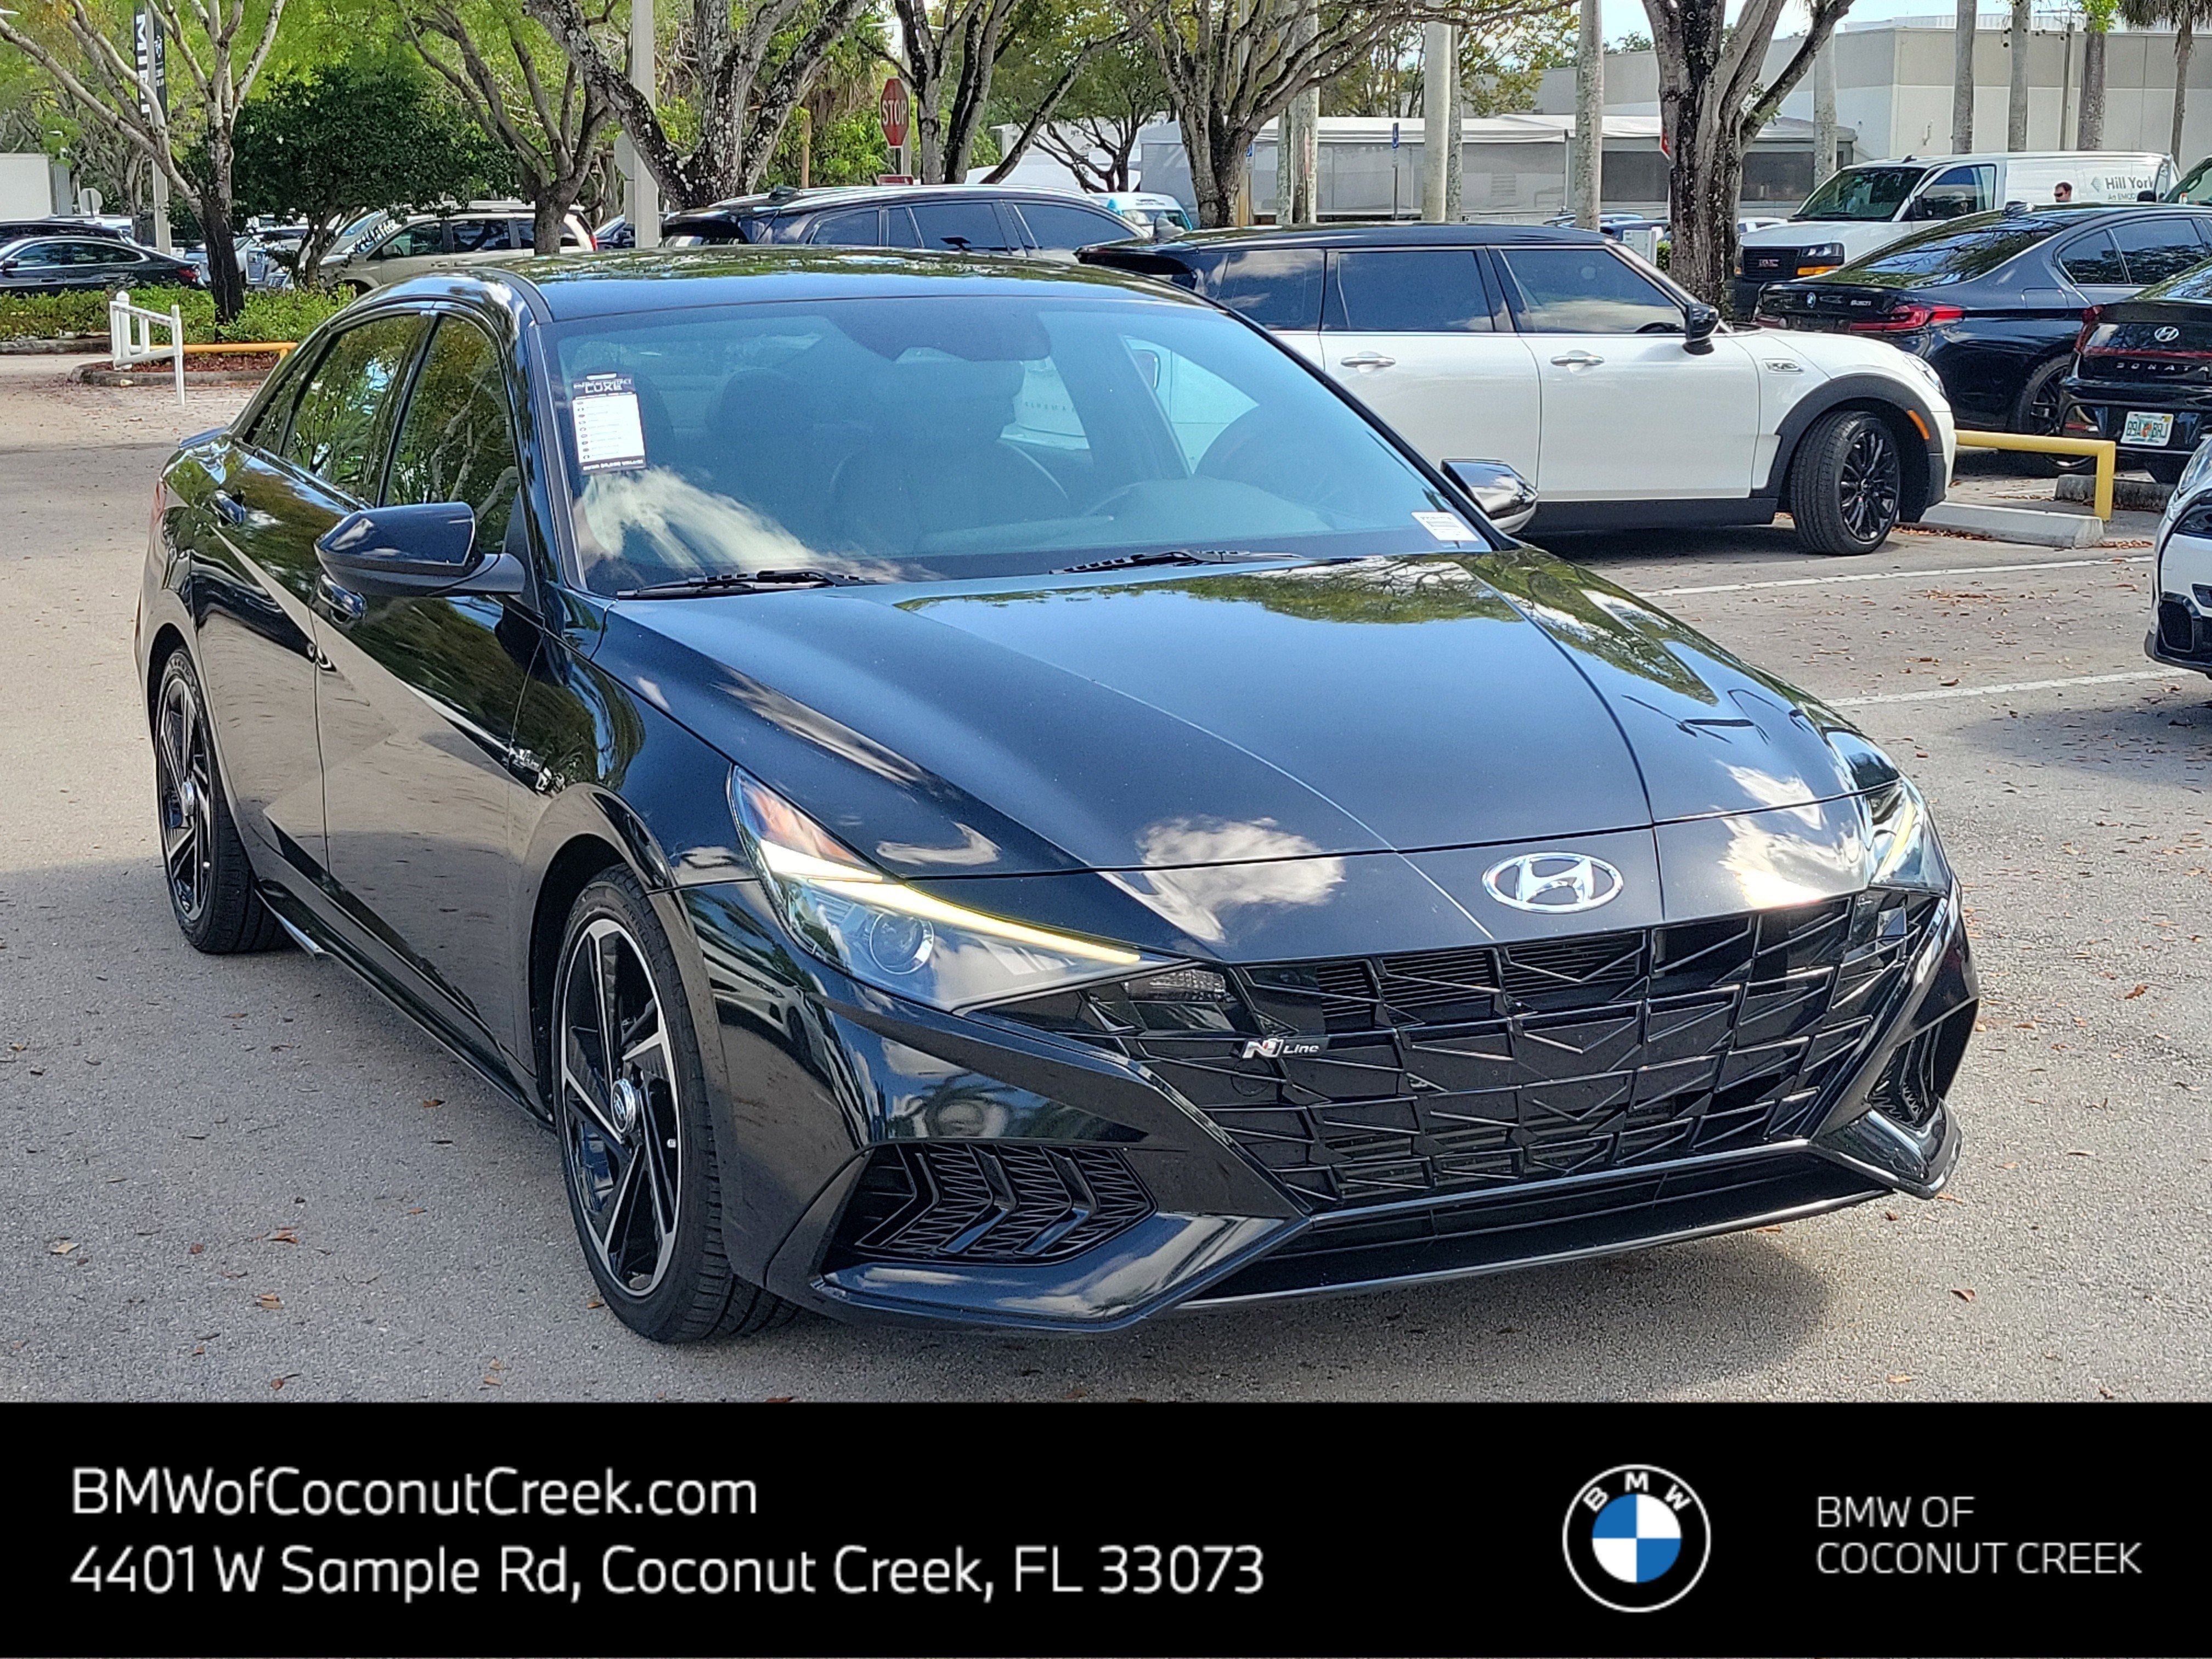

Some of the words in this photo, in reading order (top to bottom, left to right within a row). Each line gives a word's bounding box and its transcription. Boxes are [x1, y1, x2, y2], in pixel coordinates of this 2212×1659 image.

[882, 99, 907, 126] STOP
[2105, 176, 2126, 189] Hill
[2128, 176, 2153, 189] York
[2116, 362, 2210, 373] SONATA
